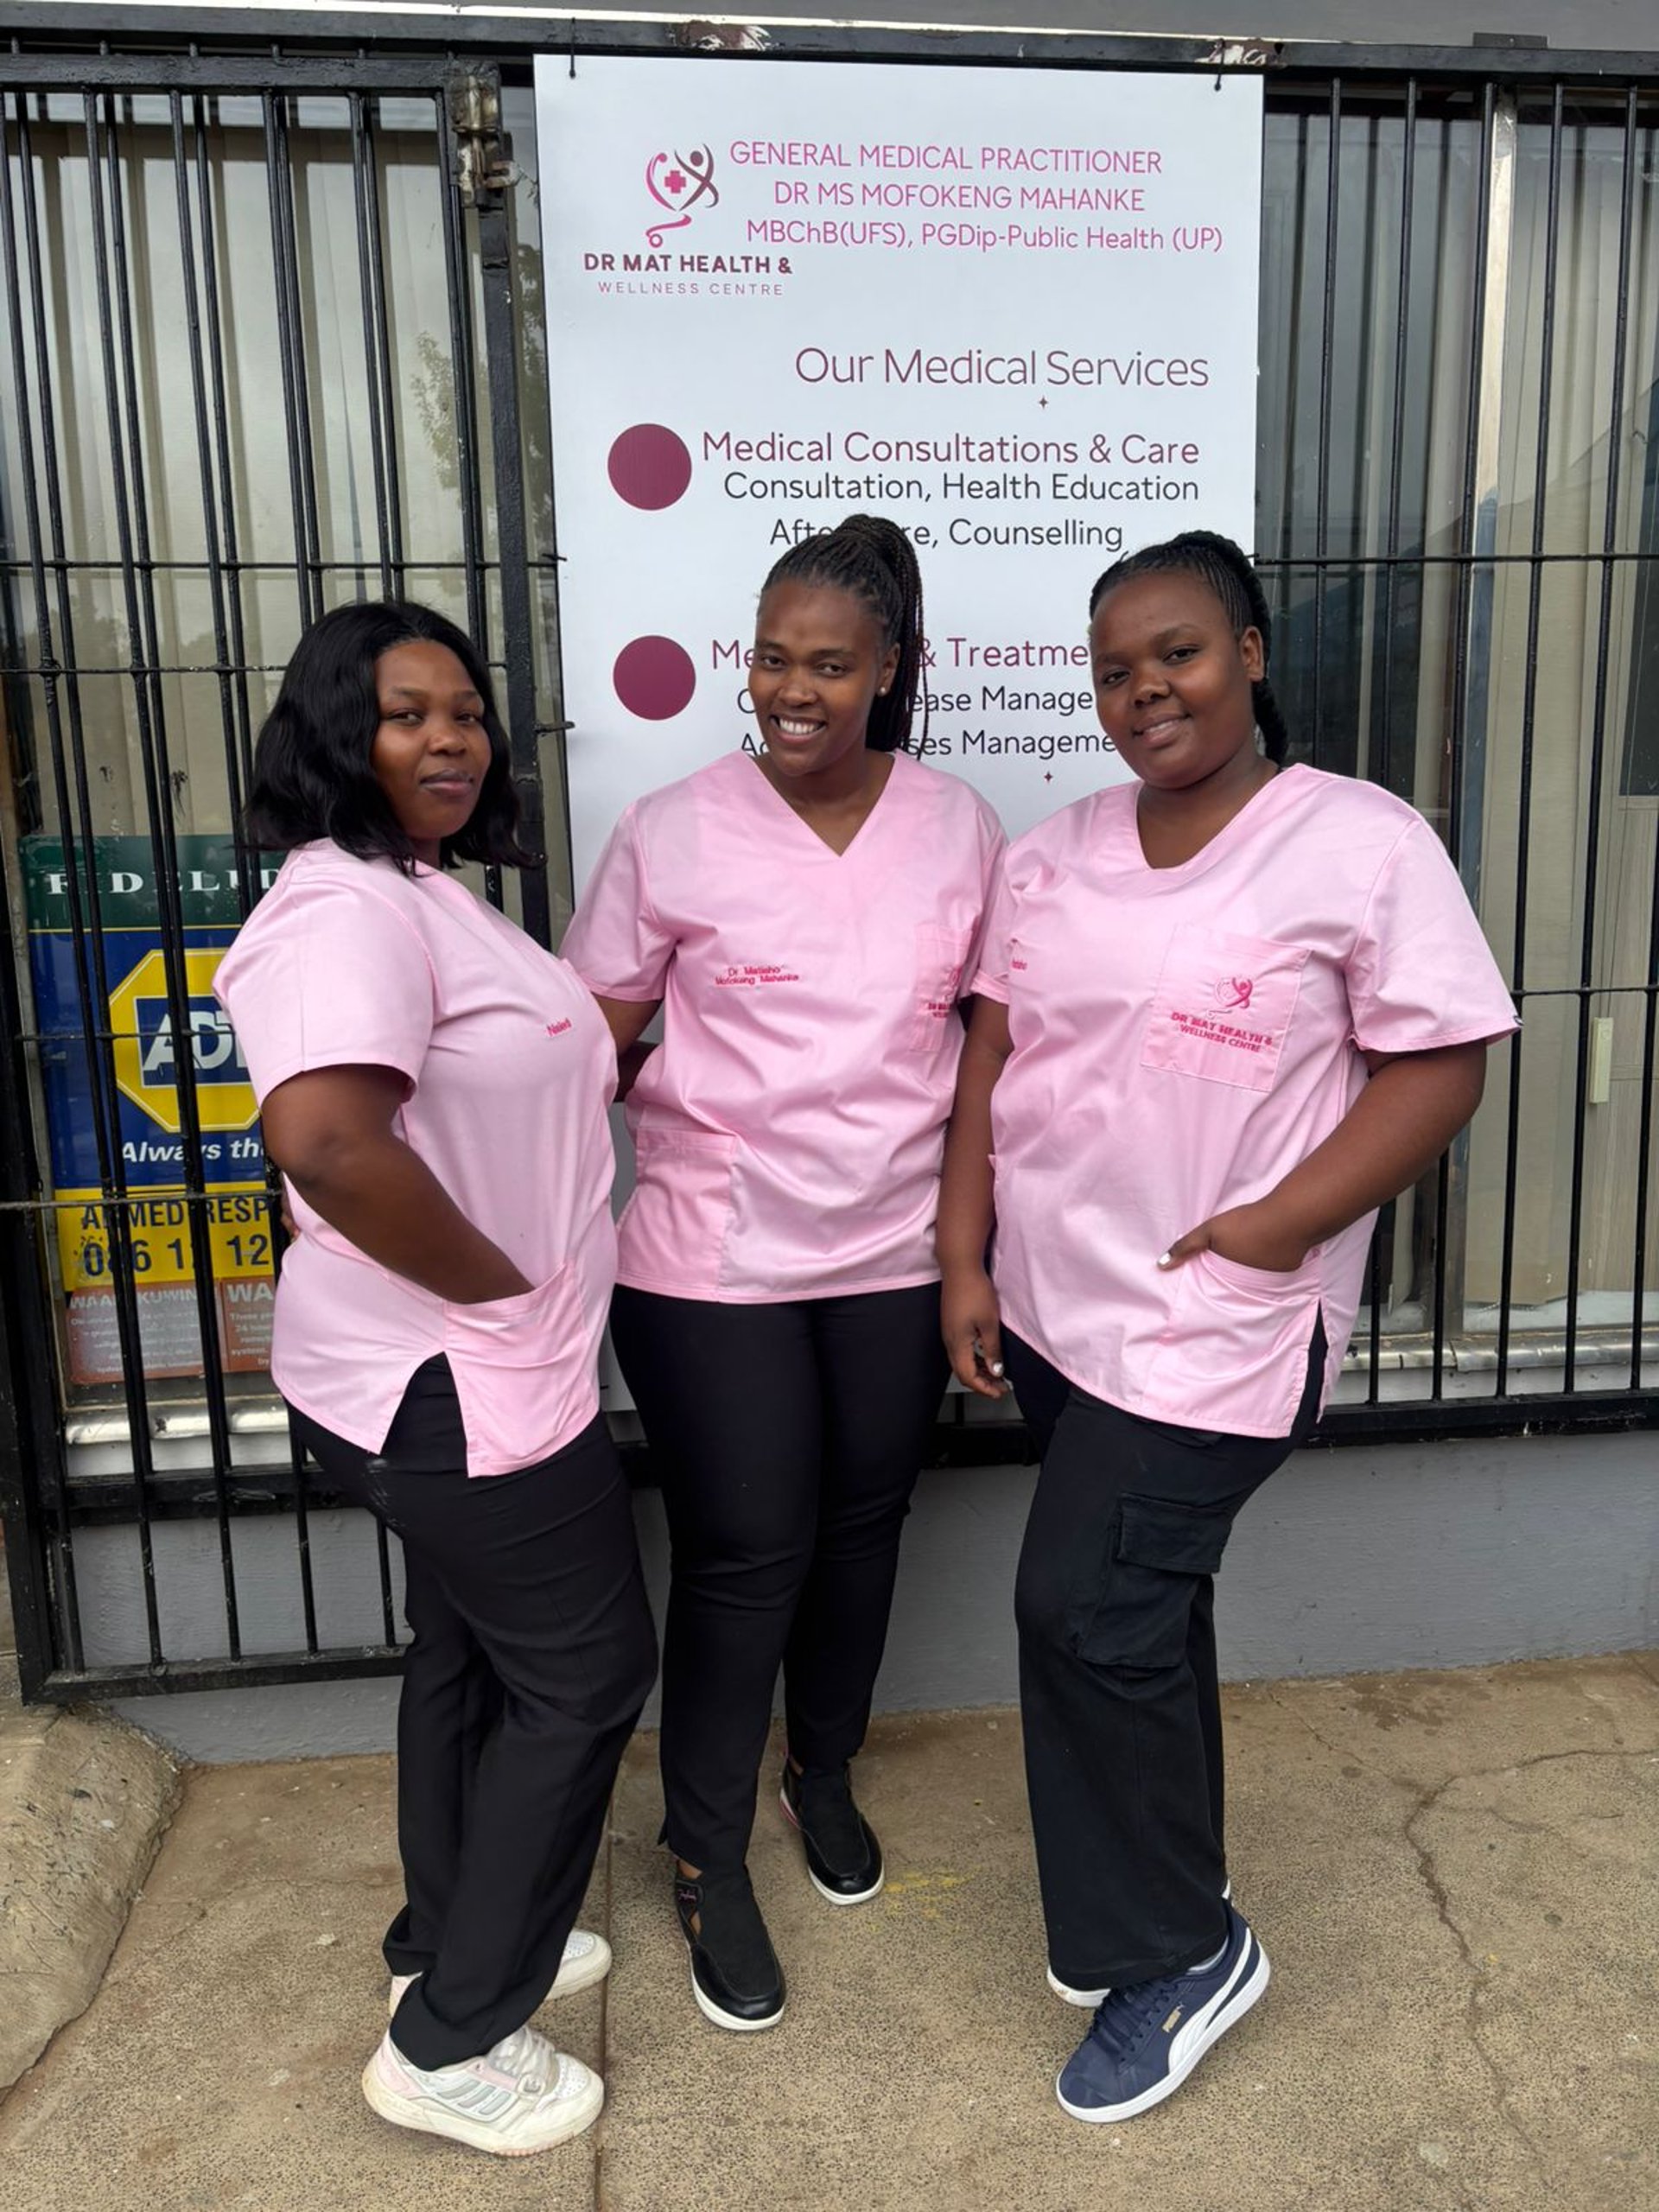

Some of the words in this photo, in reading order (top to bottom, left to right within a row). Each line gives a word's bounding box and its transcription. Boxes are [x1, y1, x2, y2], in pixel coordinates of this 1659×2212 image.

[729, 140, 852, 167] GENERAL
[860, 144, 973, 169] MEDICAL
[981, 147, 1162, 174] PRACTITIONER
[774, 181, 810, 205] DR
[817, 182, 855, 206] MS
[861, 183, 1012, 209] MOFOKENG
[1020, 187, 1145, 212] MAHANKE
[747, 219, 913, 248] MBChB(UFS),
[922, 222, 1078, 253] PGDip-Public
[1087, 226, 1164, 250] Health
[1173, 226, 1223, 253] (UP)
[583, 252, 615, 271] DR
[622, 253, 673, 272] MAT
[679, 254, 771, 274] HEALTH
[777, 257, 793, 275] &
[598, 281, 700, 295] WELLNESS
[709, 283, 783, 296] CENTRE
[795, 346, 874, 384] Our
[885, 348, 1036, 385] Medical
[1046, 350, 1209, 387] Services
[702, 430, 832, 462] Medical
[843, 431, 1079, 464] Consultations
[1089, 433, 1112, 464] &
[1121, 433, 1199, 465] Care
[723, 471, 931, 503] Consultation,
[943, 472, 1041, 500] Health
[1052, 473, 1199, 501] Education
[949, 518, 1122, 553] Counselling
[947, 638, 1089, 668] Treatme
[912, 691, 972, 713] ease
[981, 684, 1094, 716] Manage
[962, 729, 1117, 760] Manageme
[1170, 1011, 1188, 1023] DR
[1191, 1015, 1217, 1032] MAT
[1218, 1024, 1264, 1045] HEALTH
[1179, 1023, 1227, 1044] WELLNESS
[1228, 1037, 1262, 1052] CENTRE
[122, 1141, 221, 1163] Alwas
[81, 1198, 184, 1230] AMED
[207, 1196, 270, 1224] RESP
[83, 1239, 152, 1277] 06
